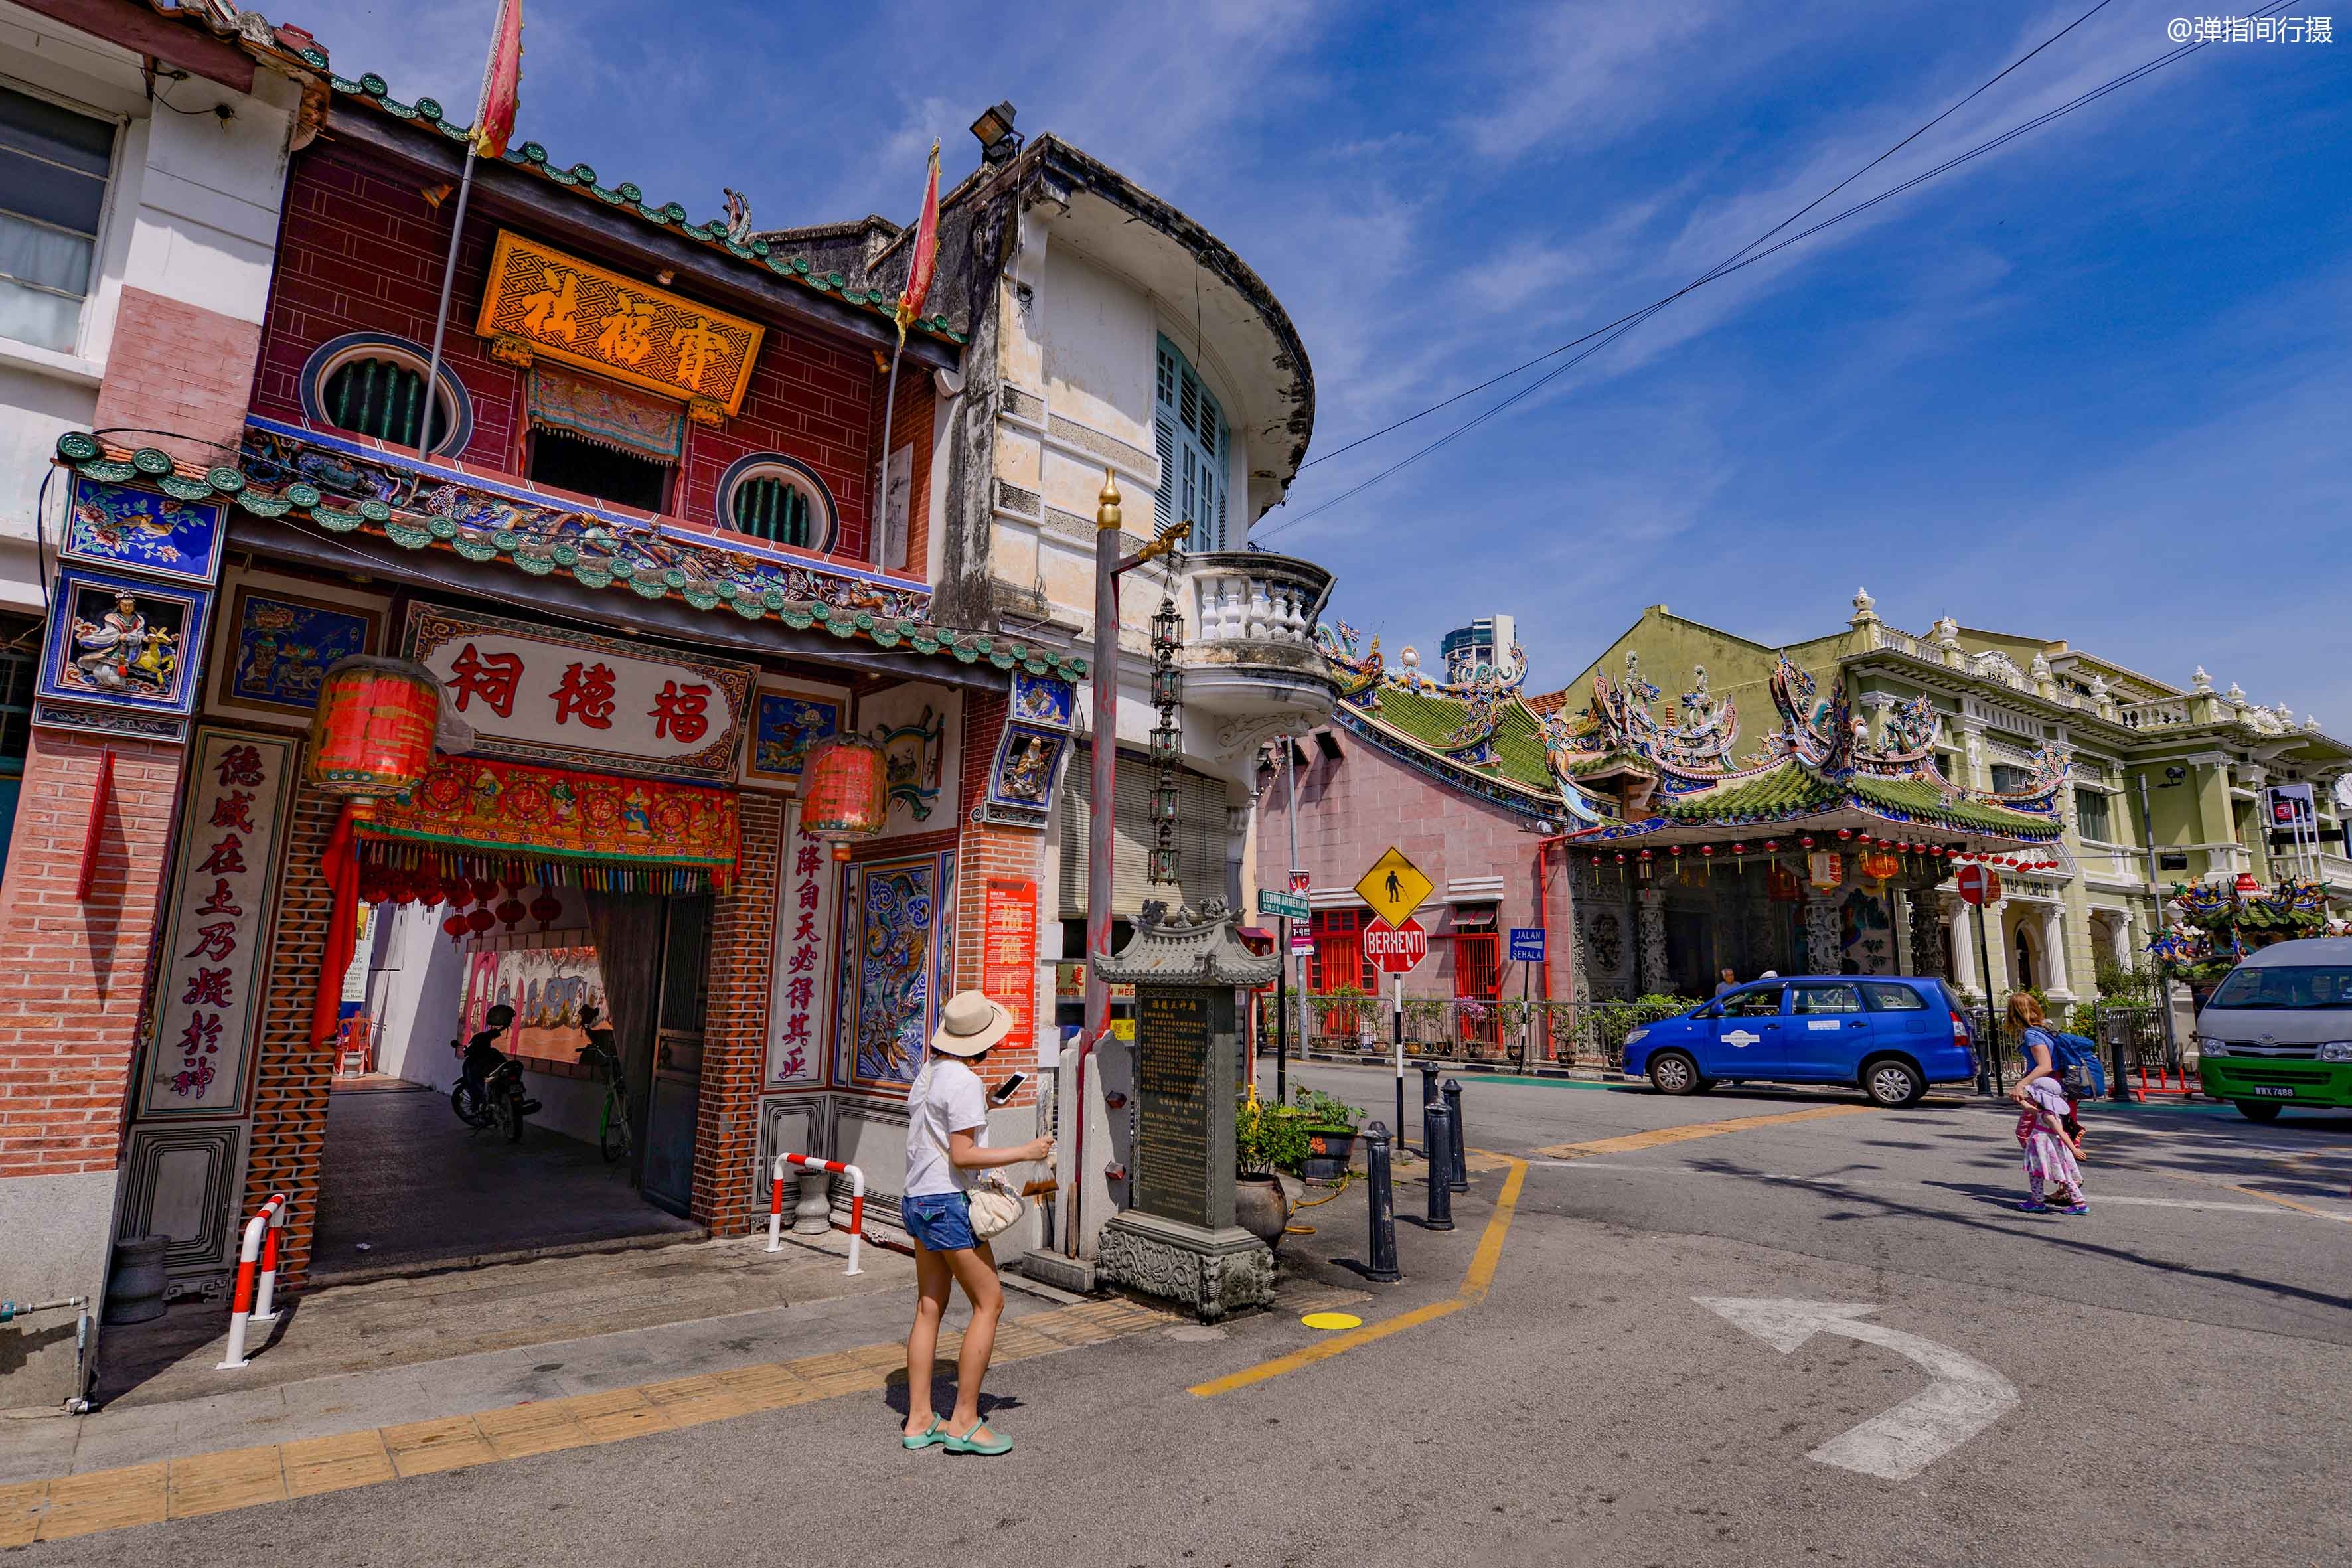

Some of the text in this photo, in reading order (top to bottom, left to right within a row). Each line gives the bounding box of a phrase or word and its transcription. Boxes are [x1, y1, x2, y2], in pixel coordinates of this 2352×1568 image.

[1263, 892, 1308, 911] LEBUH ARMENIAN
[1516, 931, 1541, 939] JALAN
[1368, 931, 1424, 954] BERHENTI
[1512, 950, 1541, 959] SEHALA
